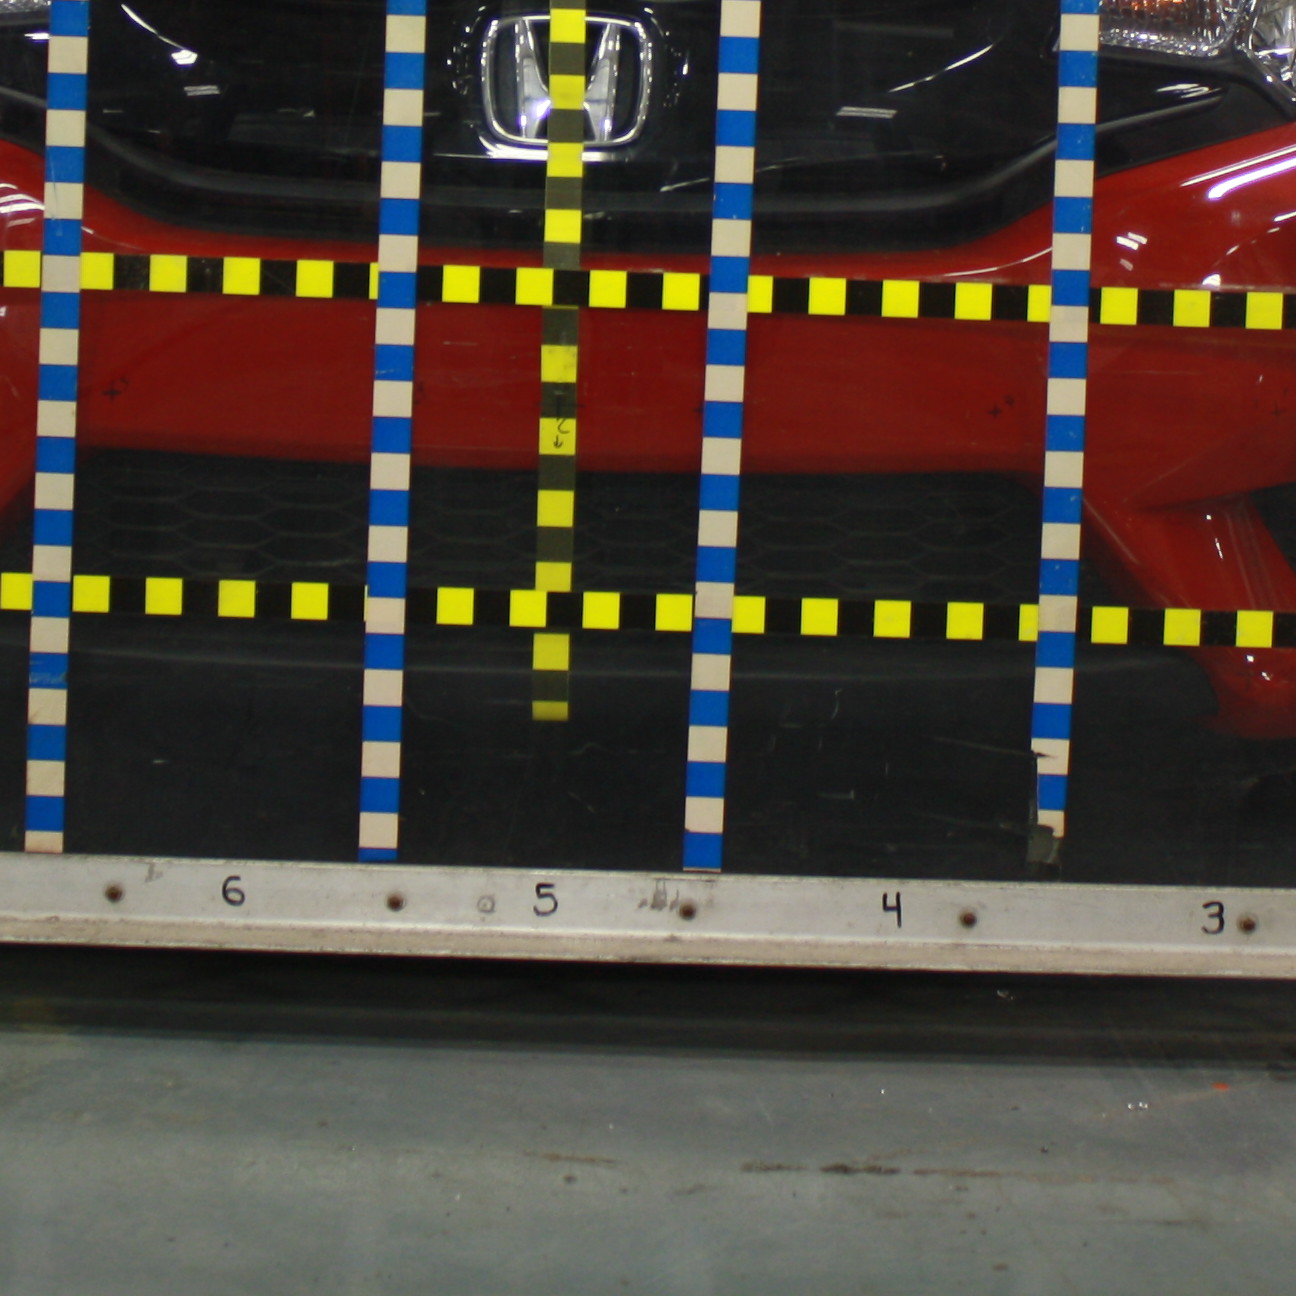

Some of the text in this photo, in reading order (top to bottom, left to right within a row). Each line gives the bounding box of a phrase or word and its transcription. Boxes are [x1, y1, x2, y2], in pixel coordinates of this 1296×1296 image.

[221, 875, 246, 907] 6
[533, 882, 559, 917] 5
[881, 891, 903, 929] 4
[1201, 901, 1226, 936] 3
